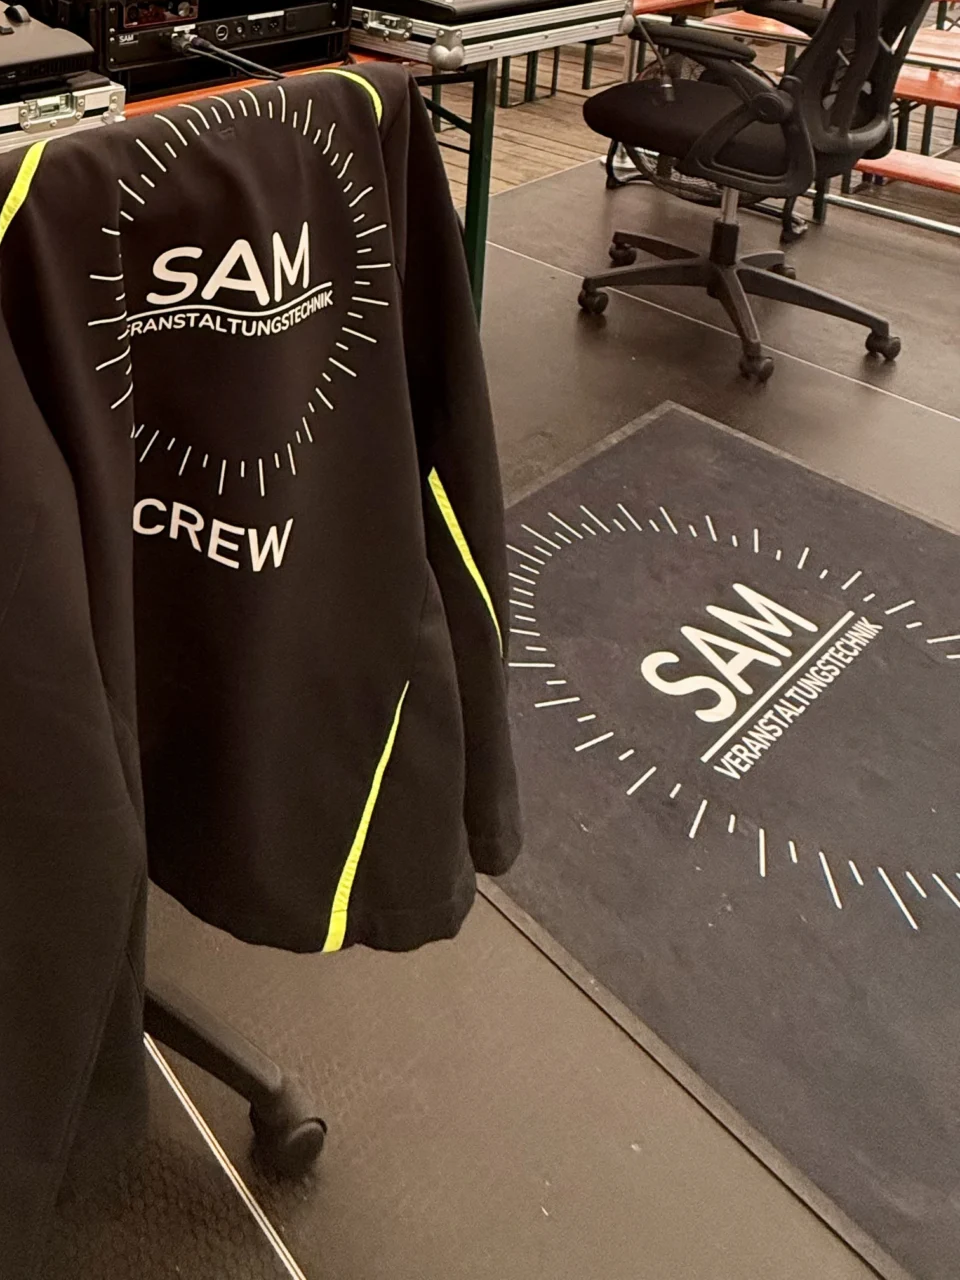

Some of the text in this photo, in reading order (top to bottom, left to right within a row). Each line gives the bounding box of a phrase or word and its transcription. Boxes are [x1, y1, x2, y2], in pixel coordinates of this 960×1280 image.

[119, 34, 134, 43] SAM
[146, 221, 311, 306] SAM
[126, 290, 333, 336] RANSTALTUNGSTECHNIK
[132, 498, 293, 572] CREW
[641, 583, 818, 722] SAM
[714, 616, 883, 780] VERANSTALTUNGSTECHNIK
